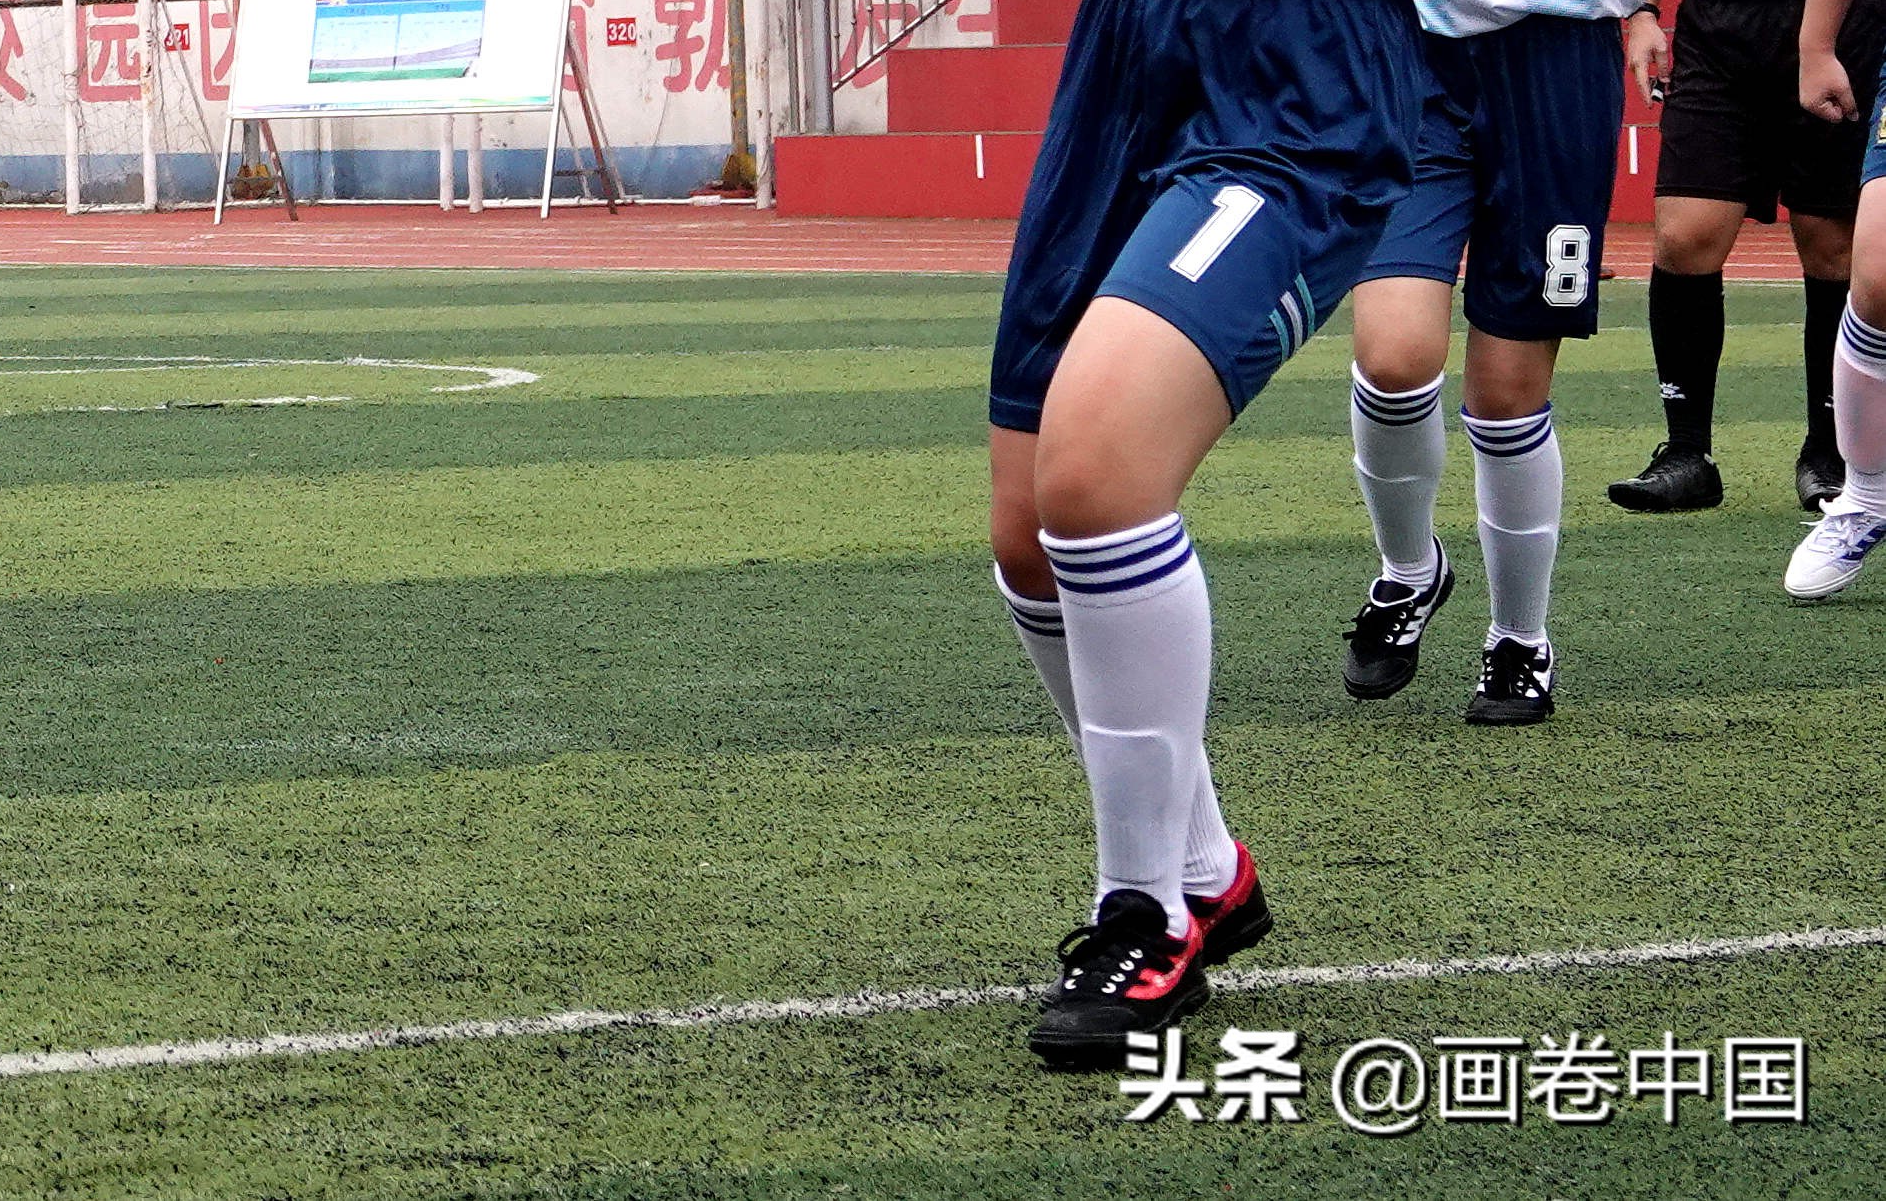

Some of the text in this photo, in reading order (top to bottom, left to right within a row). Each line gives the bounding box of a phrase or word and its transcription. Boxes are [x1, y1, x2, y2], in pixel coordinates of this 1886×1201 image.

[608, 22, 636, 41] 320
[1170, 185, 1265, 282] 1
[1543, 225, 1590, 307] 8
